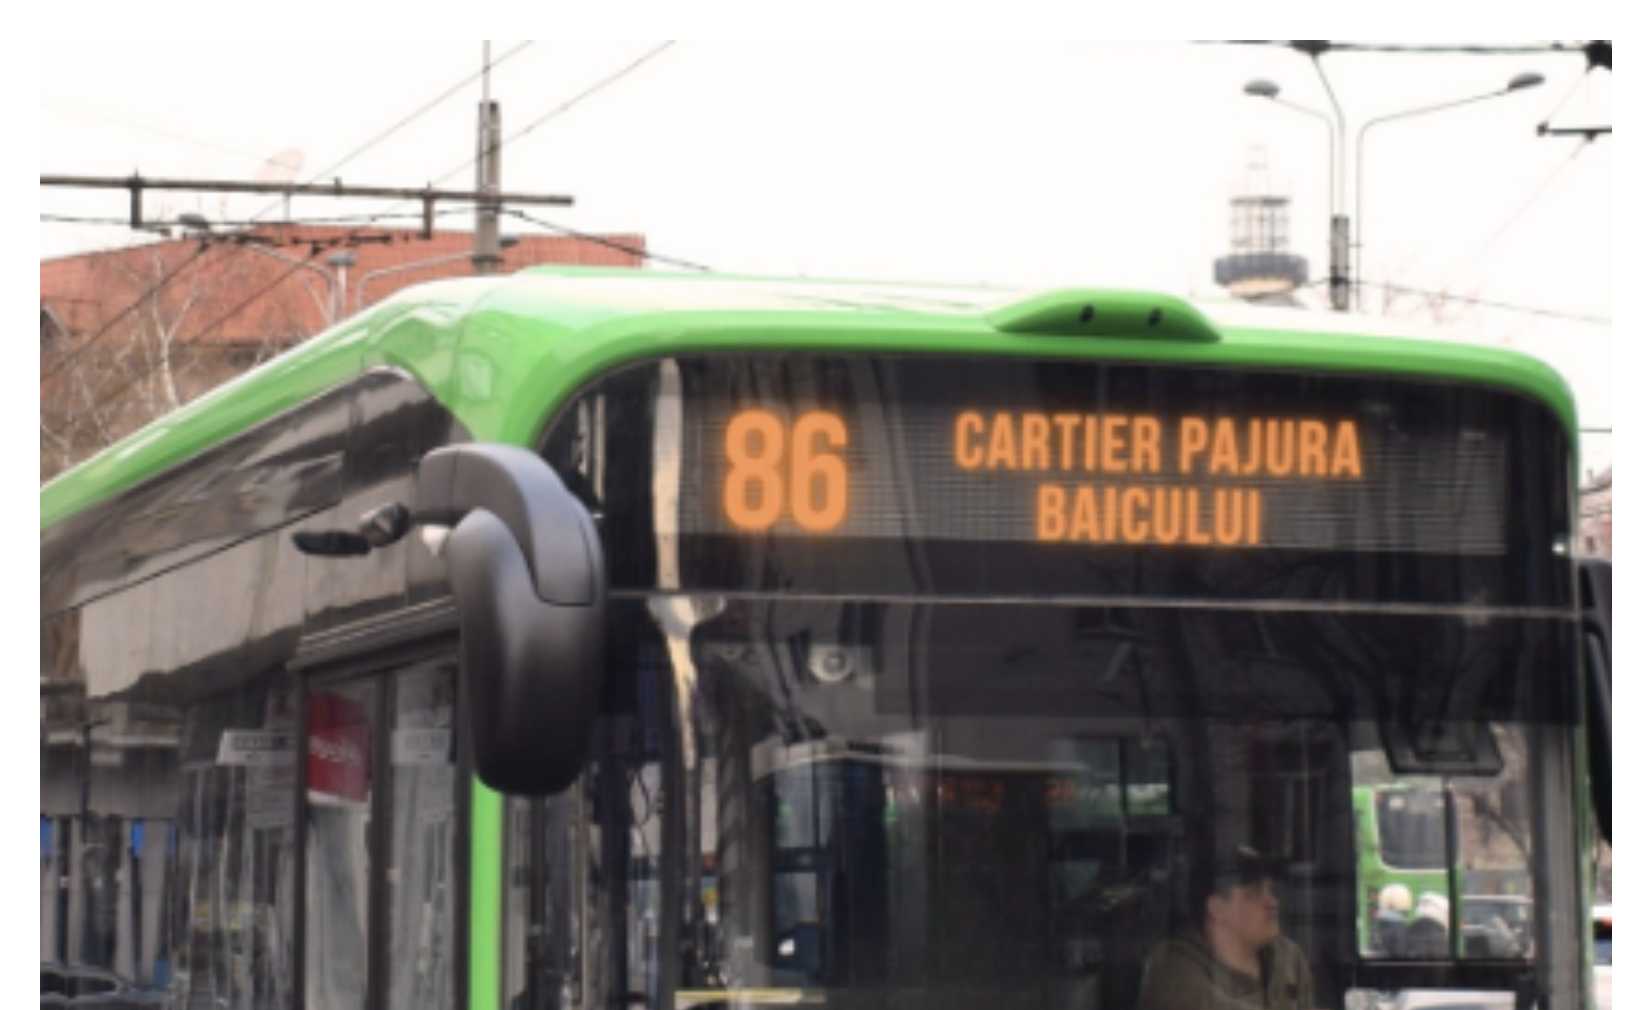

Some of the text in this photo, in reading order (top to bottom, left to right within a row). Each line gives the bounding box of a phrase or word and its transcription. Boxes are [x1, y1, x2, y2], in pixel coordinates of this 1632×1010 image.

[723, 410, 849, 532] 86
[954, 412, 1362, 478] CARTIER PAJURA
[1036, 485, 1263, 545] BAICULUI
